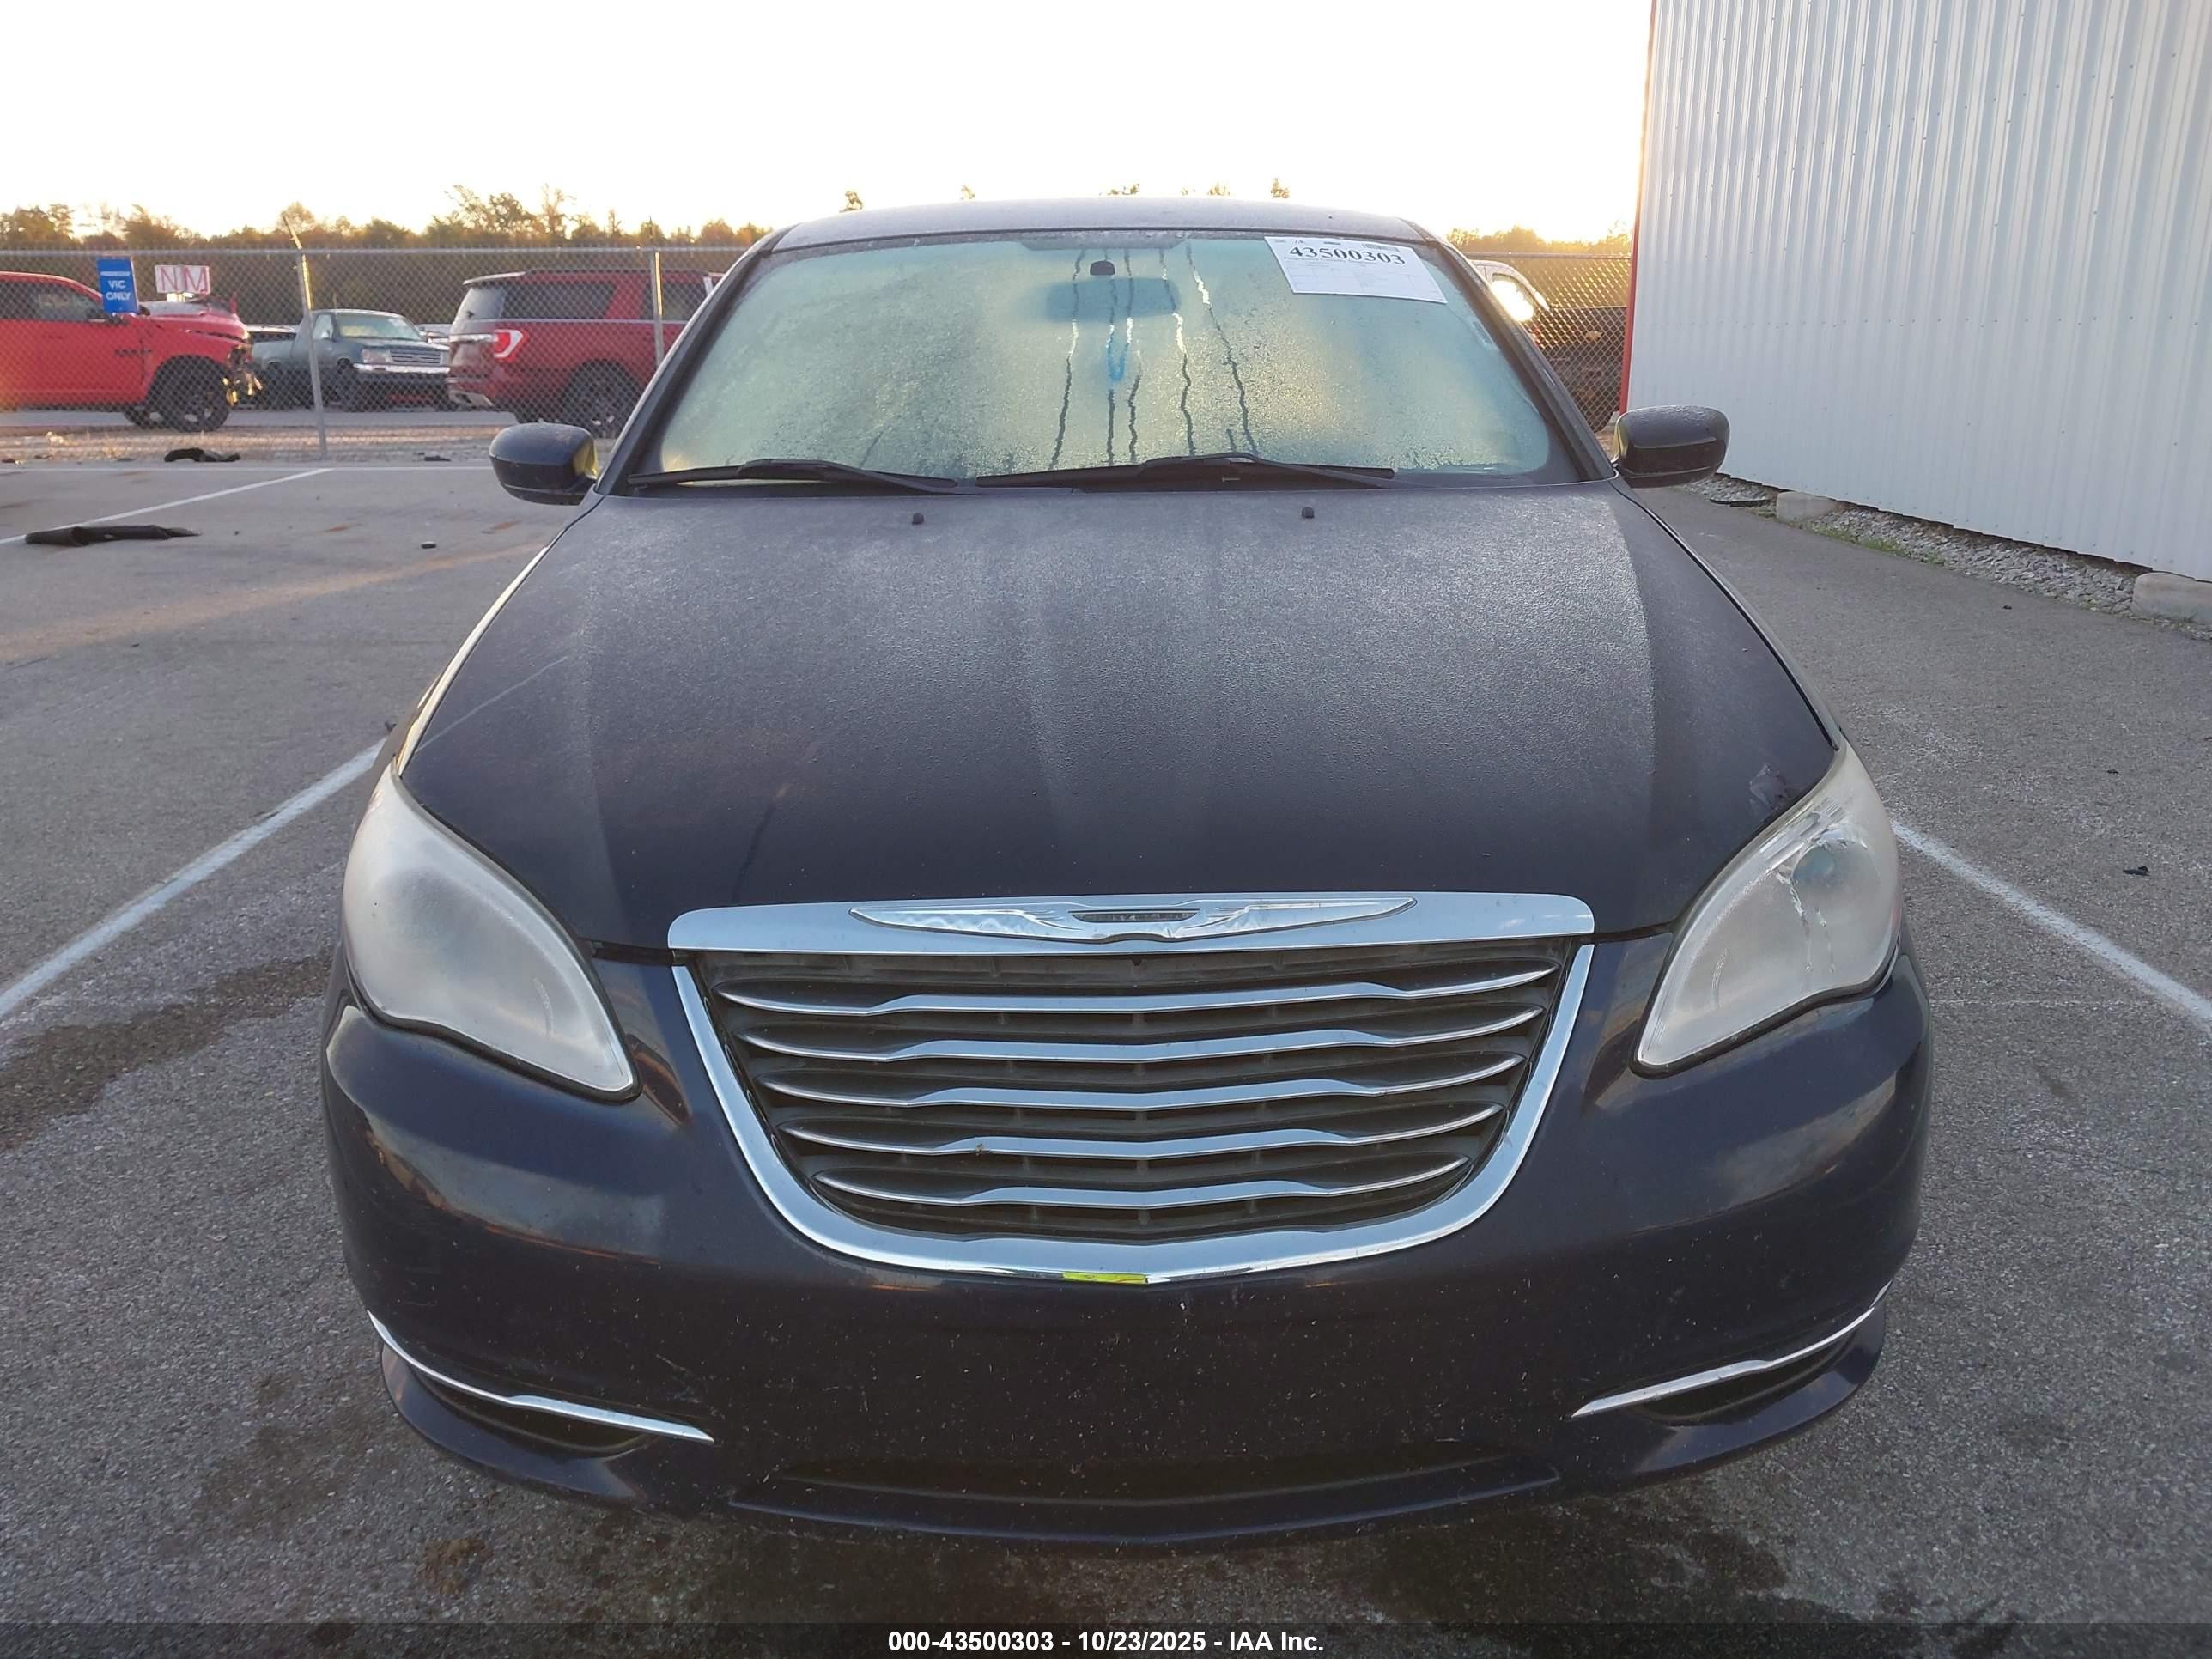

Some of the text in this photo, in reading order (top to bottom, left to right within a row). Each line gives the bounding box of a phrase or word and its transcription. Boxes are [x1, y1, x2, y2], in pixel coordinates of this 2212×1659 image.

[1289, 246, 1406, 265] 43500303
[108, 280, 126, 289] VIC
[106, 292, 131, 301] ONLY
